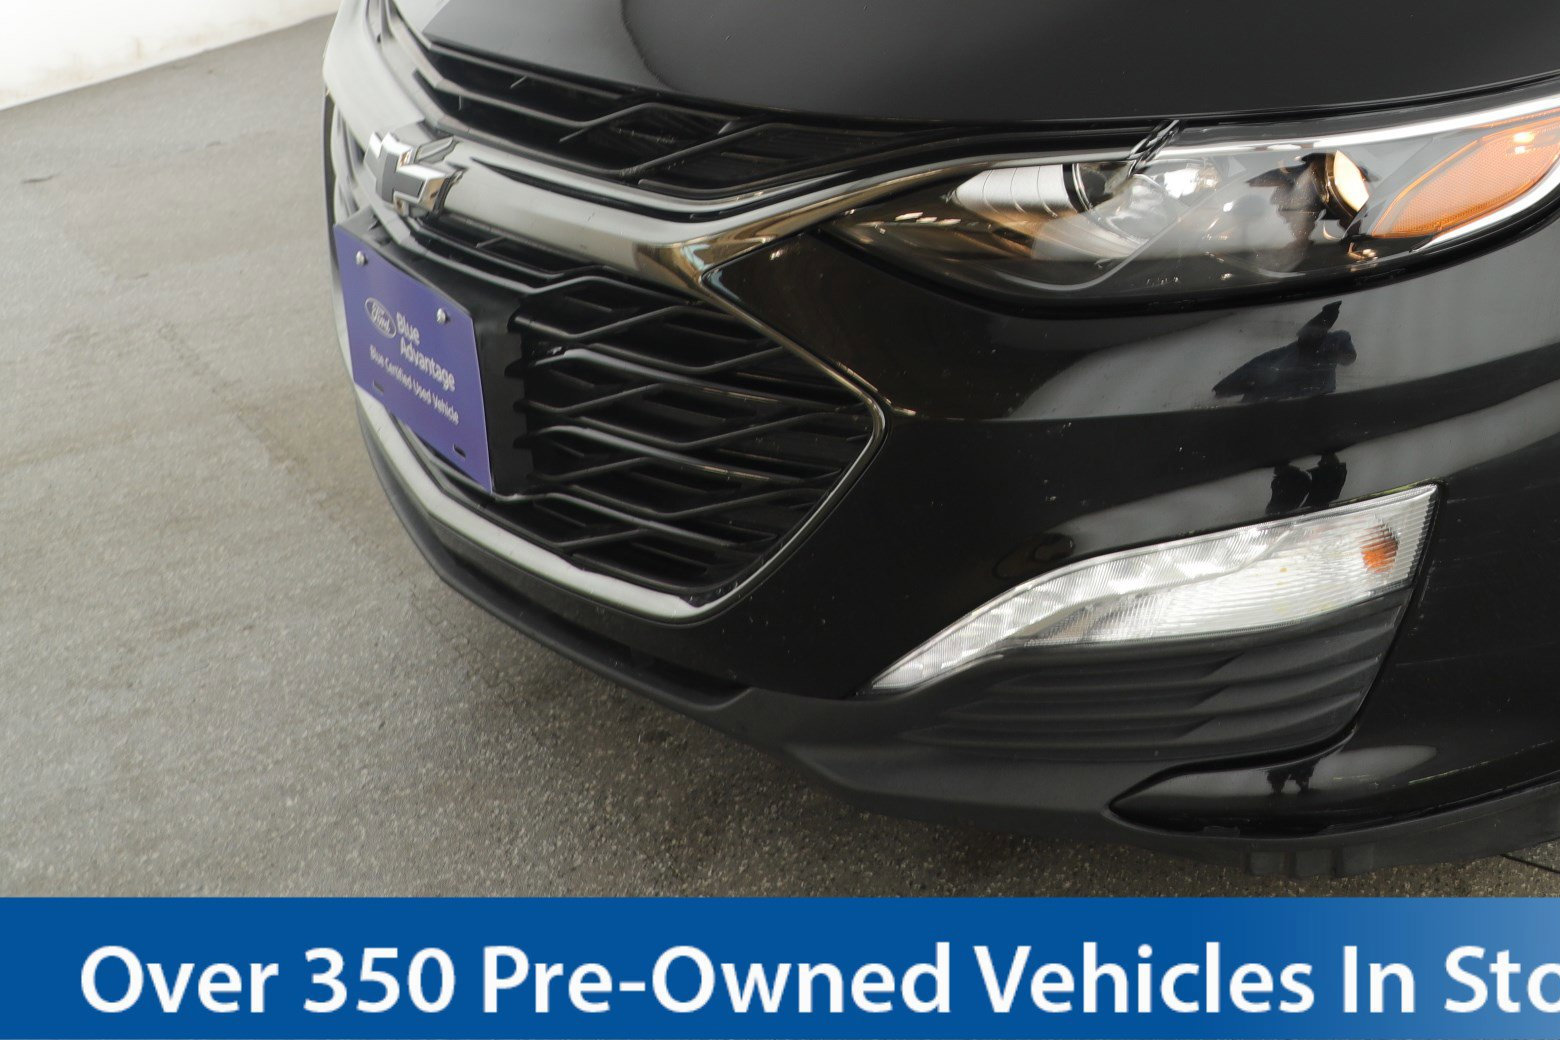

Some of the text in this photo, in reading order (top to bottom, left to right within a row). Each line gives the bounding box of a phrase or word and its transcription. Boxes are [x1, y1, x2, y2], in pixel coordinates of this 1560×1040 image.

[396, 311, 420, 346] Blue
[370, 344, 460, 426] Blue Certified Used Vehicle
[400, 336, 456, 392] Advantage
